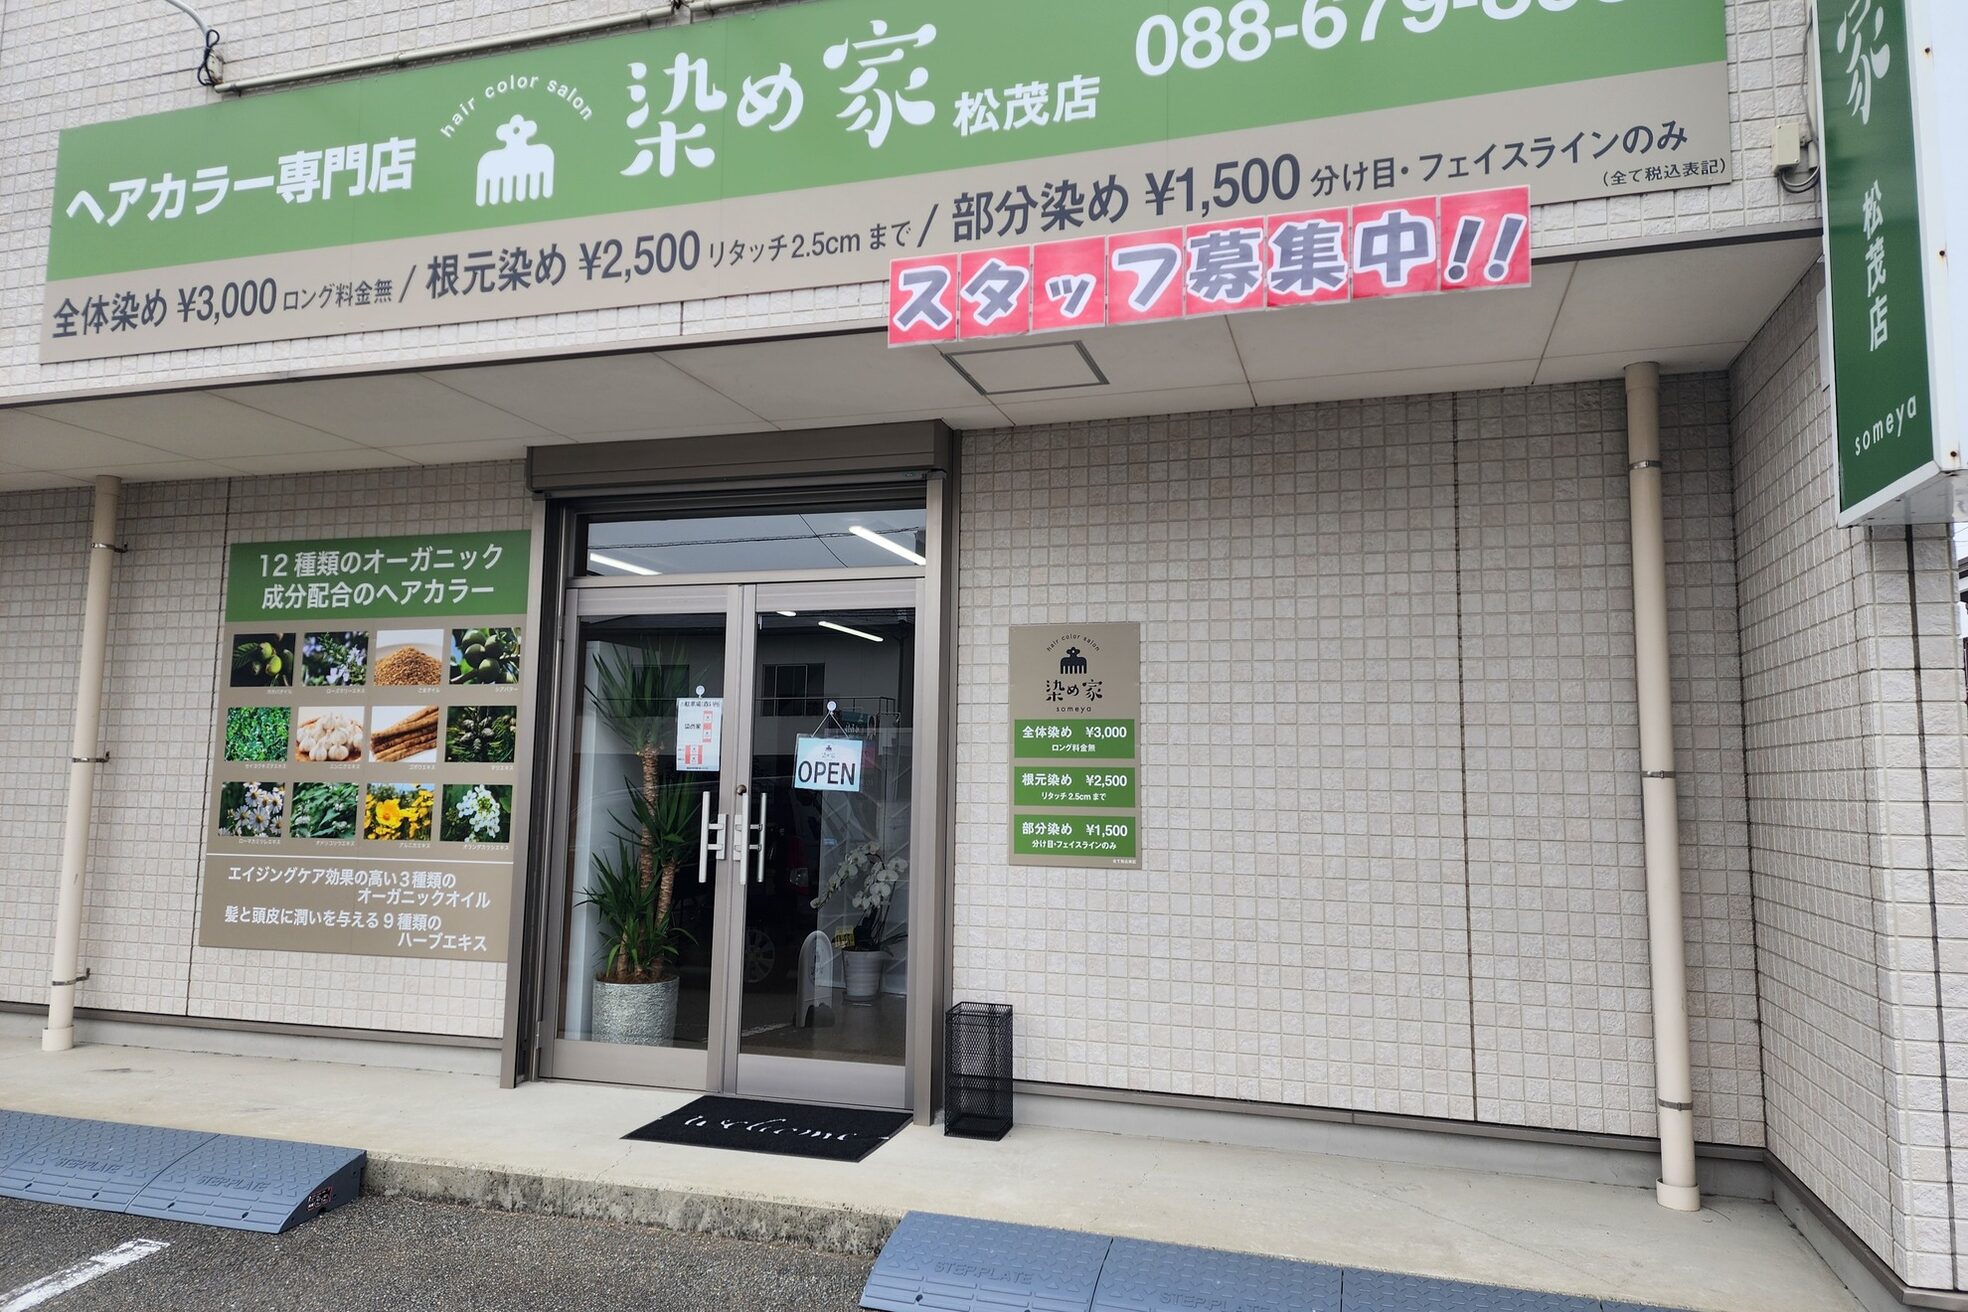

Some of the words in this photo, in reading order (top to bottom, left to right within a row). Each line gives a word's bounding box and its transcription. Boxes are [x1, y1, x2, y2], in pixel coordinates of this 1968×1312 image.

[1135, 0, 1630, 77] 088-679-
[440, 97, 479, 139] hair
[484, 74, 540, 100] color
[547, 78, 594, 123] salon
[620, 19, 937, 178] 染め家
[952, 75, 1101, 137] 松茂店
[65, 136, 418, 228] ヘアカラー専門店
[1602, 157, 1727, 187] (全て税込表記)
[52, 286, 168, 339] 全体染め
[176, 276, 278, 325] ¥3,000
[282, 276, 394, 313] ロング料金無
[425, 242, 568, 300] 根元染め
[577, 228, 701, 284] ¥2,500
[868, 218, 912, 251] まで
[950, 173, 1131, 243] 部分染め
[1143, 152, 1301, 219] ¥1,500
[1309, 119, 1689, 199] 分け目・フェイスラインのみ
[892, 208, 1528, 332] スタッフ募集中!!
[1862, 179, 1890, 353] 松茂店
[1853, 394, 1918, 457] someya
[260, 578, 495, 612] 成分配合のヘアカラー
[1046, 638, 1060, 652] hair
[1061, 633, 1081, 642] color
[1083, 635, 1101, 652] salon
[1045, 678, 1104, 702] 染め家
[1056, 705, 1092, 714] someya
[1021, 725, 1073, 739] 全体染め
[1085, 726, 1128, 740] ¥3,000
[1051, 743, 1096, 752] ロング料金無
[798, 760, 856, 786] OPEN
[1021, 772, 1073, 786] 根元染め
[1085, 774, 1128, 788] ¥2,500
[1093, 792, 1107, 801] まで
[1021, 821, 1073, 836] 部分染め
[1085, 824, 1129, 838] ¥1,500
[1031, 839, 1117, 851] 分け目・フェイスラインのみ
[227, 865, 457, 890] エイジングケア効果の高い3種類の
[357, 887, 491, 909] オーガニックオイル
[224, 904, 442, 932] 髪と頭皮に潤いを与える9種類の
[397, 931, 488, 953] ハーブエキス
